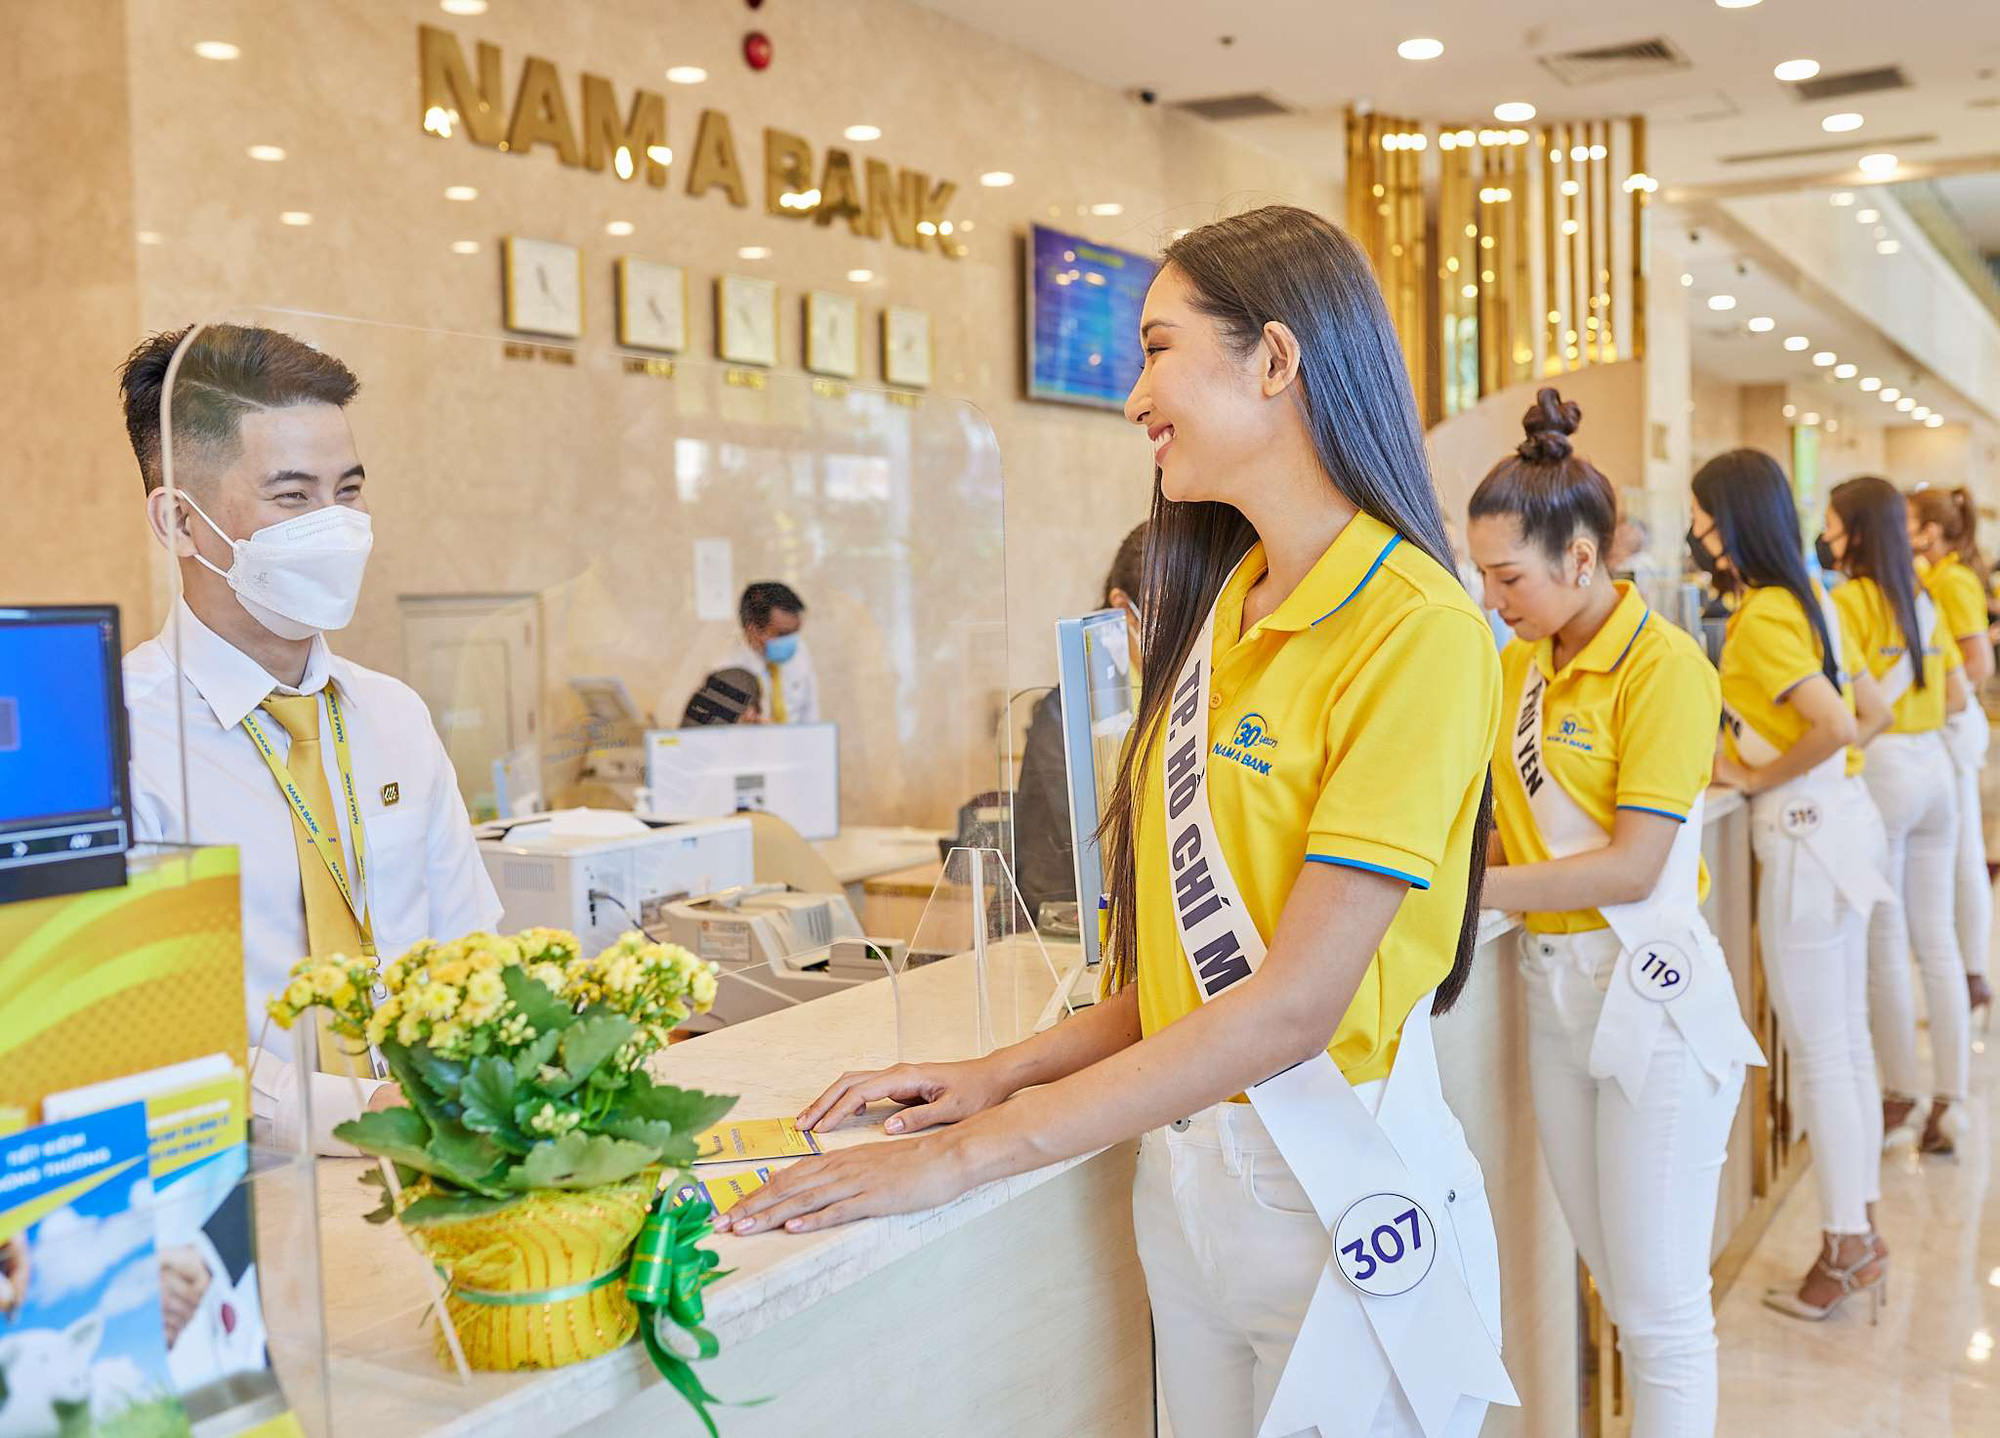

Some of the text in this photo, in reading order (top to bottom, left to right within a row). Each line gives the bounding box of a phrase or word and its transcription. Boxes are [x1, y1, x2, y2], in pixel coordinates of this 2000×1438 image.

[417, 23, 957, 260] NAM A BANK
[1168, 660, 1201, 742] TP.
[1211, 742, 1273, 776] NAM A BANK
[1233, 721, 1262, 748] 30
[286, 783, 301, 804] NAM
[302, 811, 320, 834] BANK
[1172, 823, 1231, 931] CHÍ
[1641, 952, 1681, 988] 119
[1340, 1207, 1422, 1281] 307
